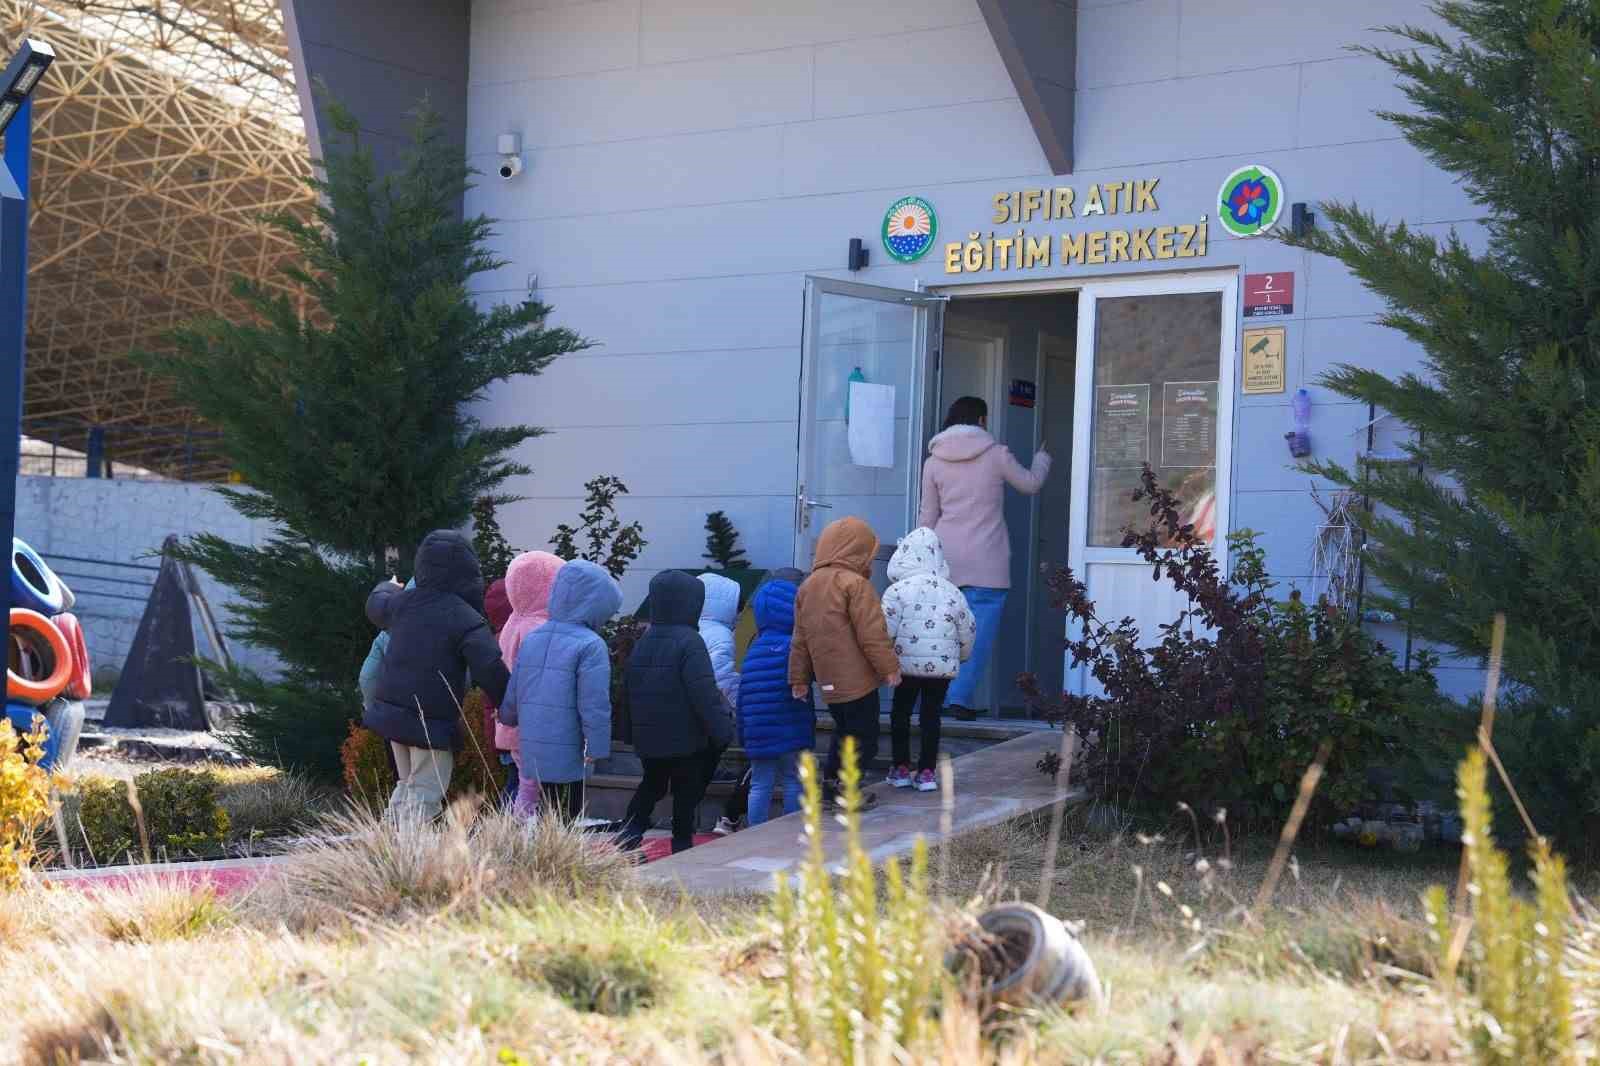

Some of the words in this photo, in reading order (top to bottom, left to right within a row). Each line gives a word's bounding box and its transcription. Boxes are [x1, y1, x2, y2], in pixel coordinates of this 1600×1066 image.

[992, 187, 1075, 224] SIFIR
[1083, 177, 1160, 216] ATIK
[944, 228, 1051, 274] EĞİTİM
[1062, 215, 1207, 265] MERKEZİ
[1264, 275, 1273, 290] 2
[1265, 294, 1272, 303] 1
